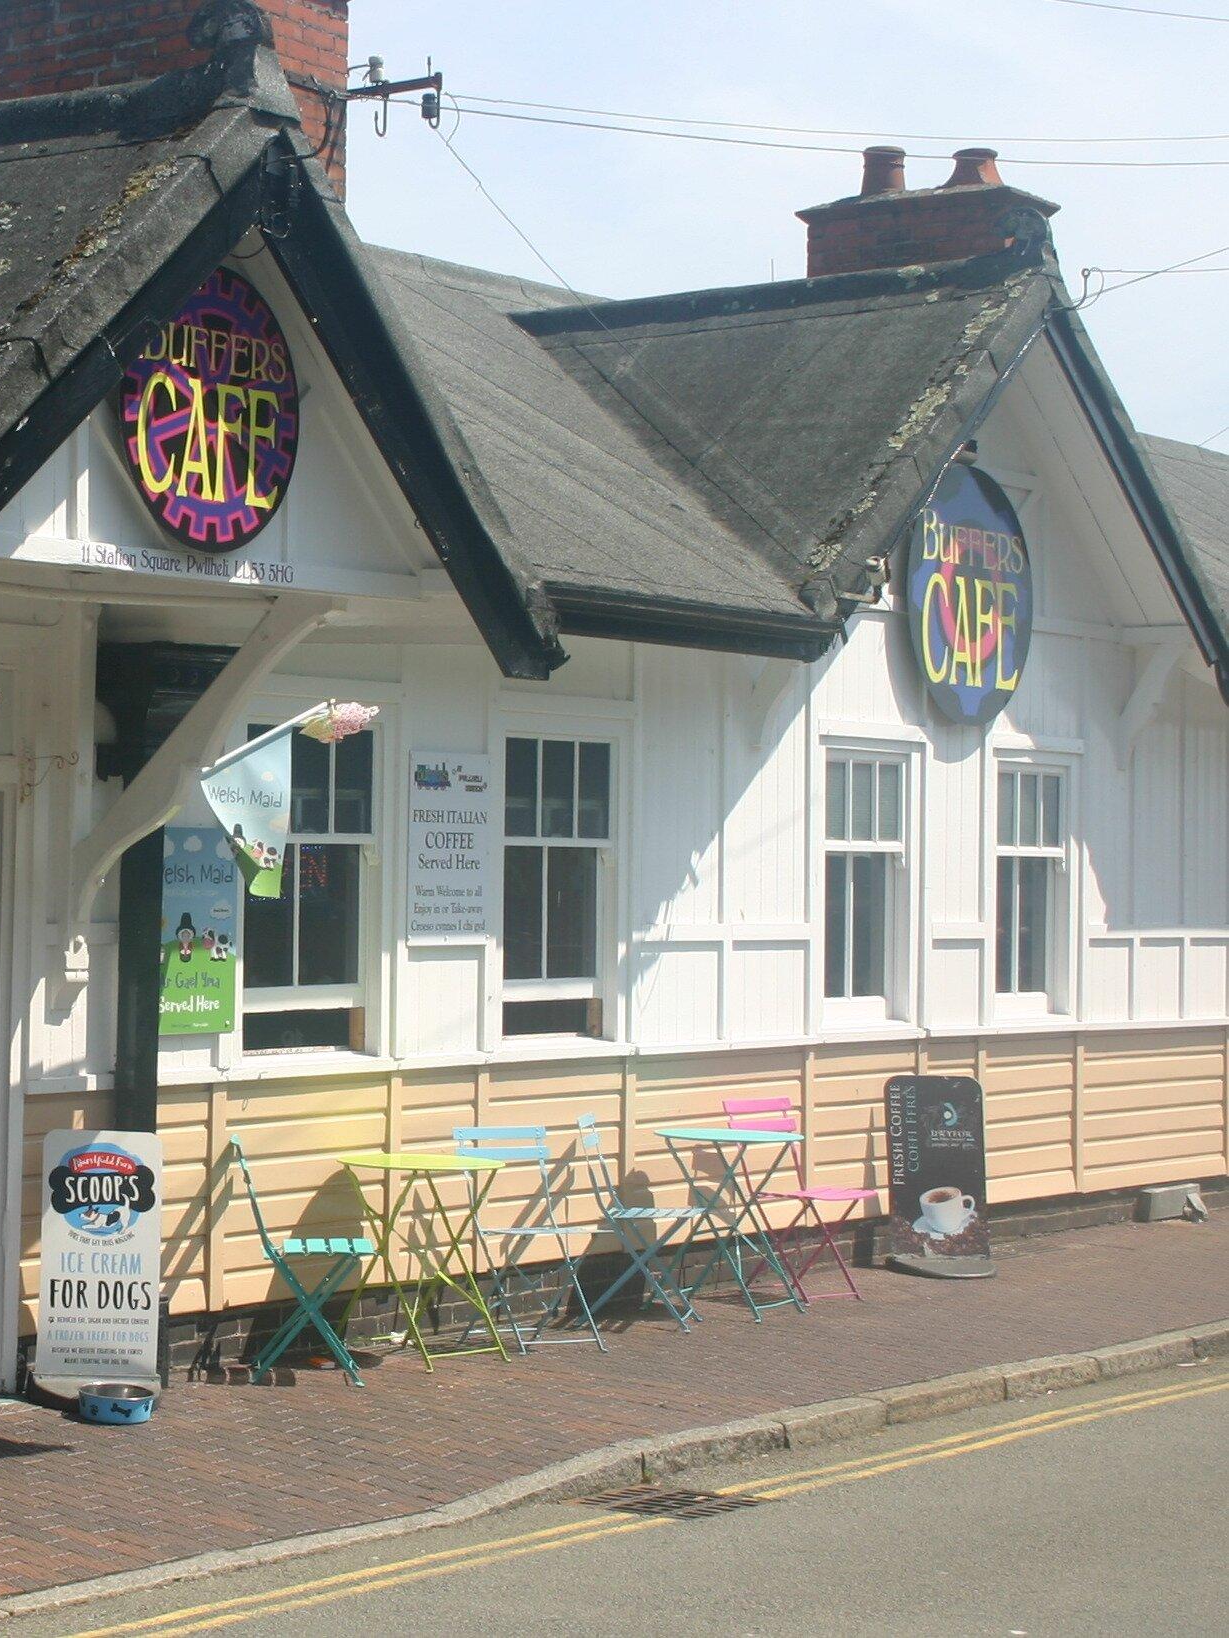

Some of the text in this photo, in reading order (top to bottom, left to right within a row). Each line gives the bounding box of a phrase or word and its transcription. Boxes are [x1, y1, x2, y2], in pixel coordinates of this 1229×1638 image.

[136, 371, 280, 510] CAFE
[922, 508, 1024, 575] BUFFERS
[94, 545, 137, 567] Station
[140, 549, 183, 573] Square,
[234, 561, 266, 580] LL53
[268, 564, 295, 583] 5HG
[921, 572, 1020, 691] CAFE
[208, 785, 282, 808] Welsh Maid
[413, 809, 488, 824] FRESH ITALIAN
[425, 831, 474, 849] COFFEE
[418, 853, 480, 870] Served Here
[163, 864, 235, 885] elsh Maid
[415, 885, 483, 897] Warm Welcome to all
[414, 902, 432, 916] Enjoy
[433, 903, 440, 914] in
[441, 906, 449, 914] or
[411, 919, 434, 931] Croeso
[158, 994, 220, 1014] Served Here
[890, 1084, 906, 1185] FRESH COFFEE
[907, 1131, 919, 1172] COFFI
[65, 1175, 140, 1204] SCOOP'S
[60, 1252, 142, 1275] ICE CREAM
[50, 1279, 151, 1311] FOR DOGS
[55, 1330, 84, 1341] FROZEN
[87, 1330, 109, 1342] TREAT
[112, 1331, 127, 1342] FOR
[129, 1331, 149, 1343] DOGS
